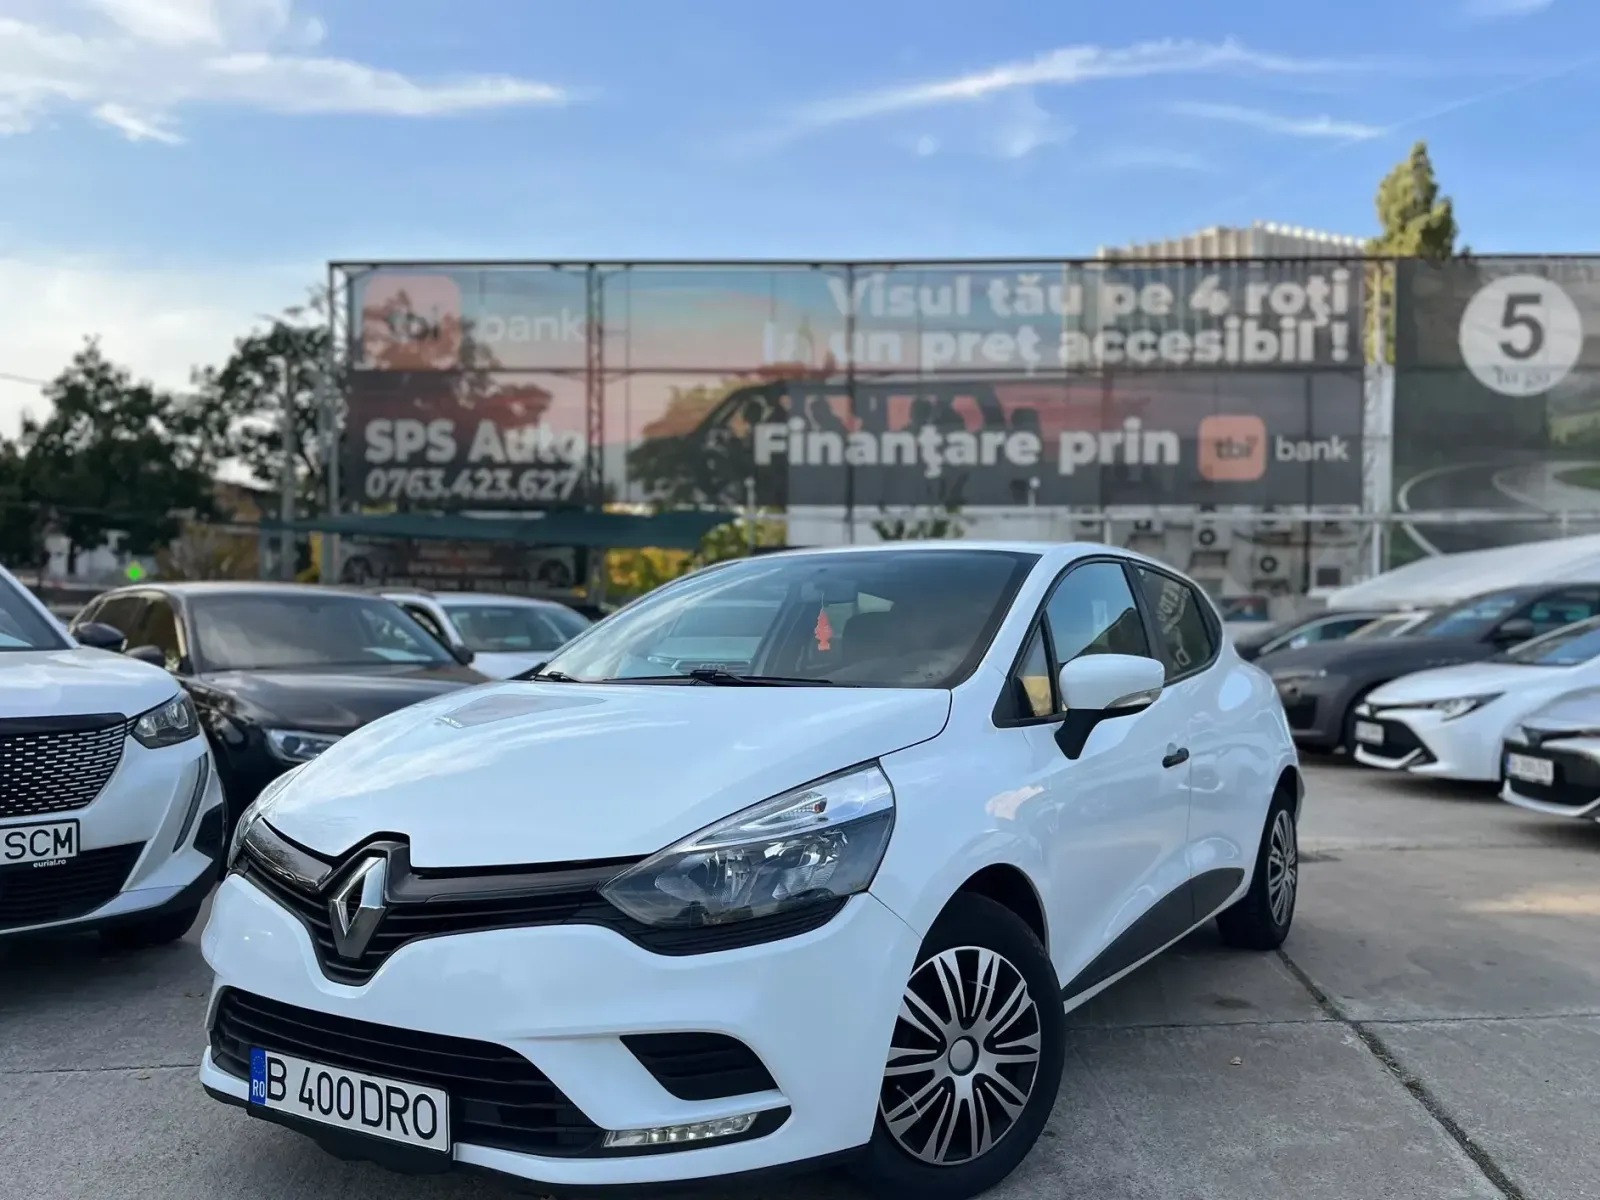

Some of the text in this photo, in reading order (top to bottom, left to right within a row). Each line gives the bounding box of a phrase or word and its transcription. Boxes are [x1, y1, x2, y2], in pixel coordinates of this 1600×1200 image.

[827, 273, 971, 317] Visul
[987, 273, 1082, 317] tău
[1101, 282, 1174, 324] pe
[1189, 274, 1230, 316] 4
[477, 308, 585, 343] bank
[829, 330, 902, 364] un
[1058, 316, 1315, 364] accesibil
[1500, 293, 1544, 360] 5
[364, 419, 587, 463] SPS Auto
[1058, 416, 1180, 475] prin
[1275, 435, 1349, 461] bank
[364, 468, 582, 500] 0763.423.627
[4, 826, 73, 860] SCM
[33, 858, 67, 868] eurial.ro
[252, 1078, 265, 1098] RO
[266, 1056, 287, 1102] B
